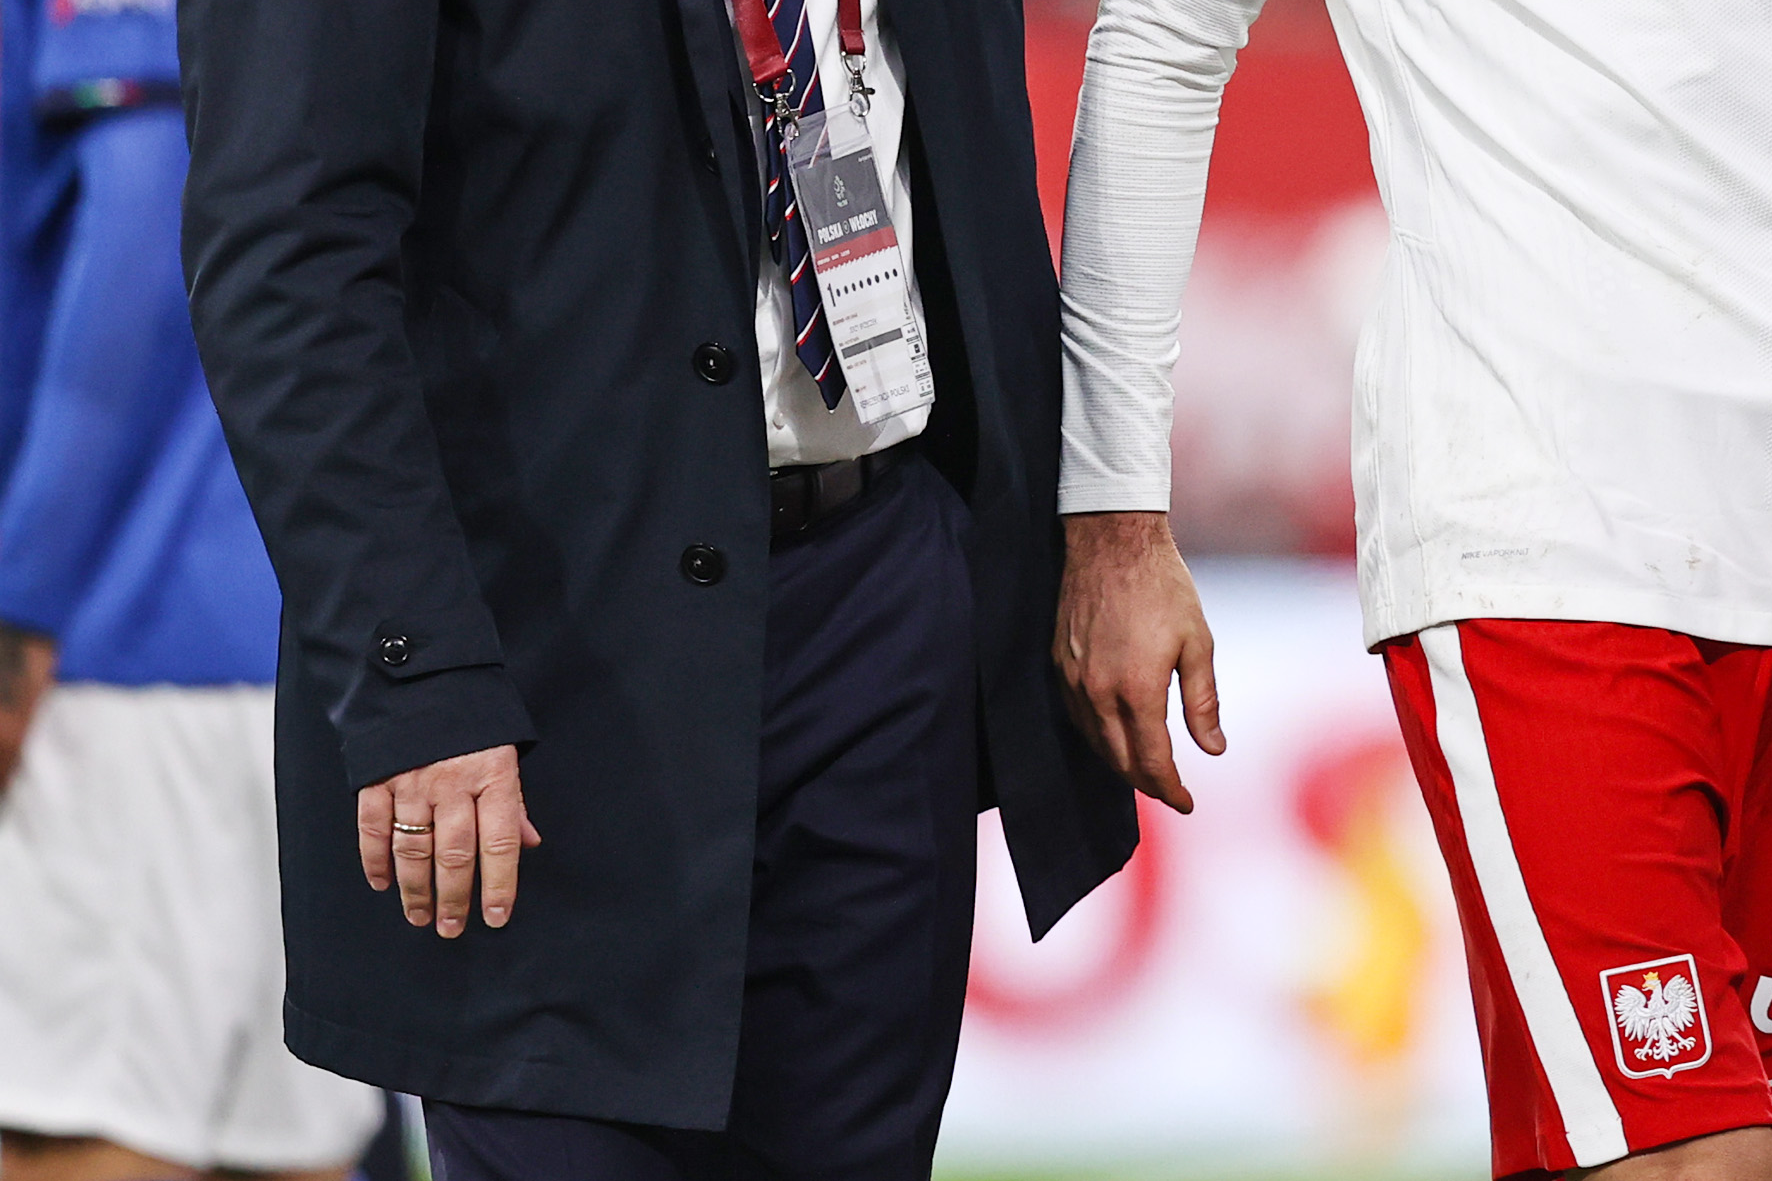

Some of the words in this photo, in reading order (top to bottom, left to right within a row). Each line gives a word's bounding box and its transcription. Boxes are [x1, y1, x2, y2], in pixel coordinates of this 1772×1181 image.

[817, 222, 844, 245] POLSKA
[849, 209, 878, 233] WŁOCHY
[1461, 550, 1481, 560] NIKE
